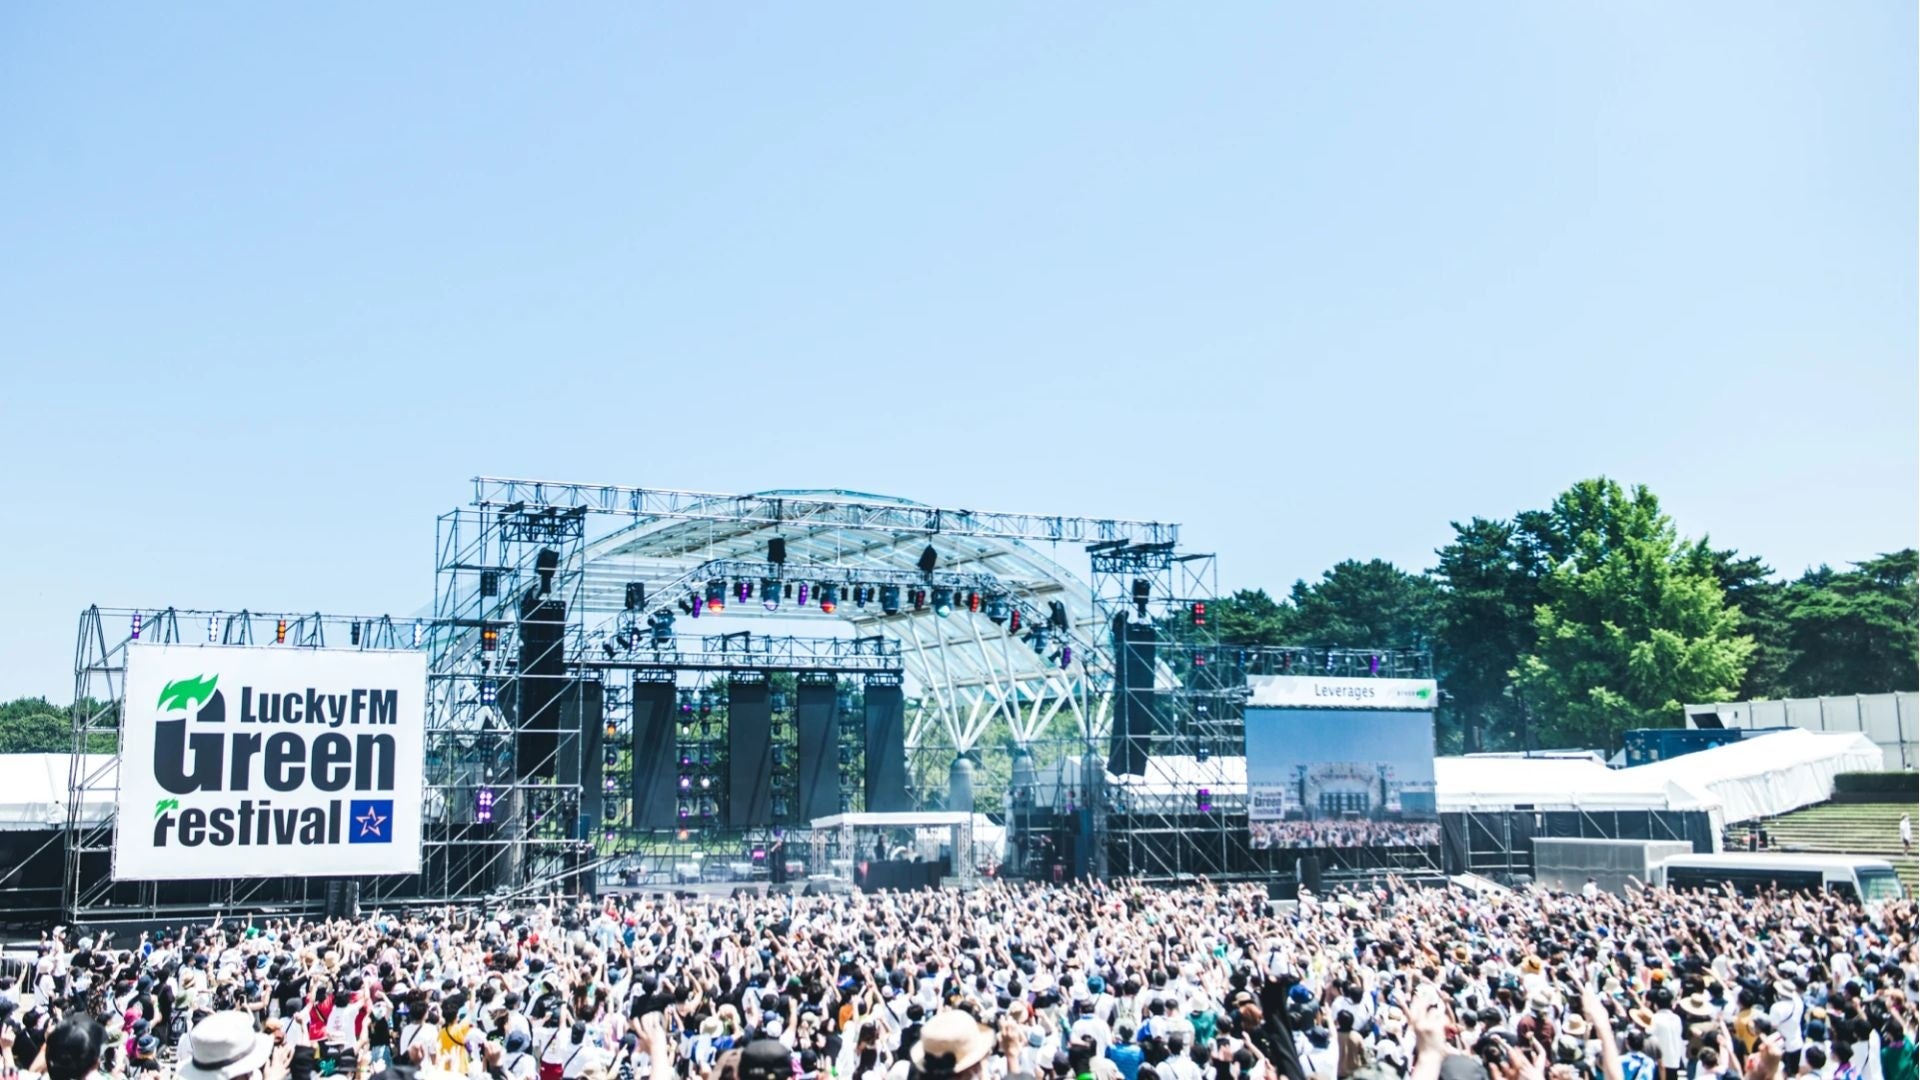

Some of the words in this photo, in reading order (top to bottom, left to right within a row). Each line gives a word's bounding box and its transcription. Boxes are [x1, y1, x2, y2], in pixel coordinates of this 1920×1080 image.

[240, 686, 398, 728] LuckyFM
[1314, 684, 1375, 700] Leverages
[154, 686, 395, 794] Green
[153, 798, 342, 847] Festival
